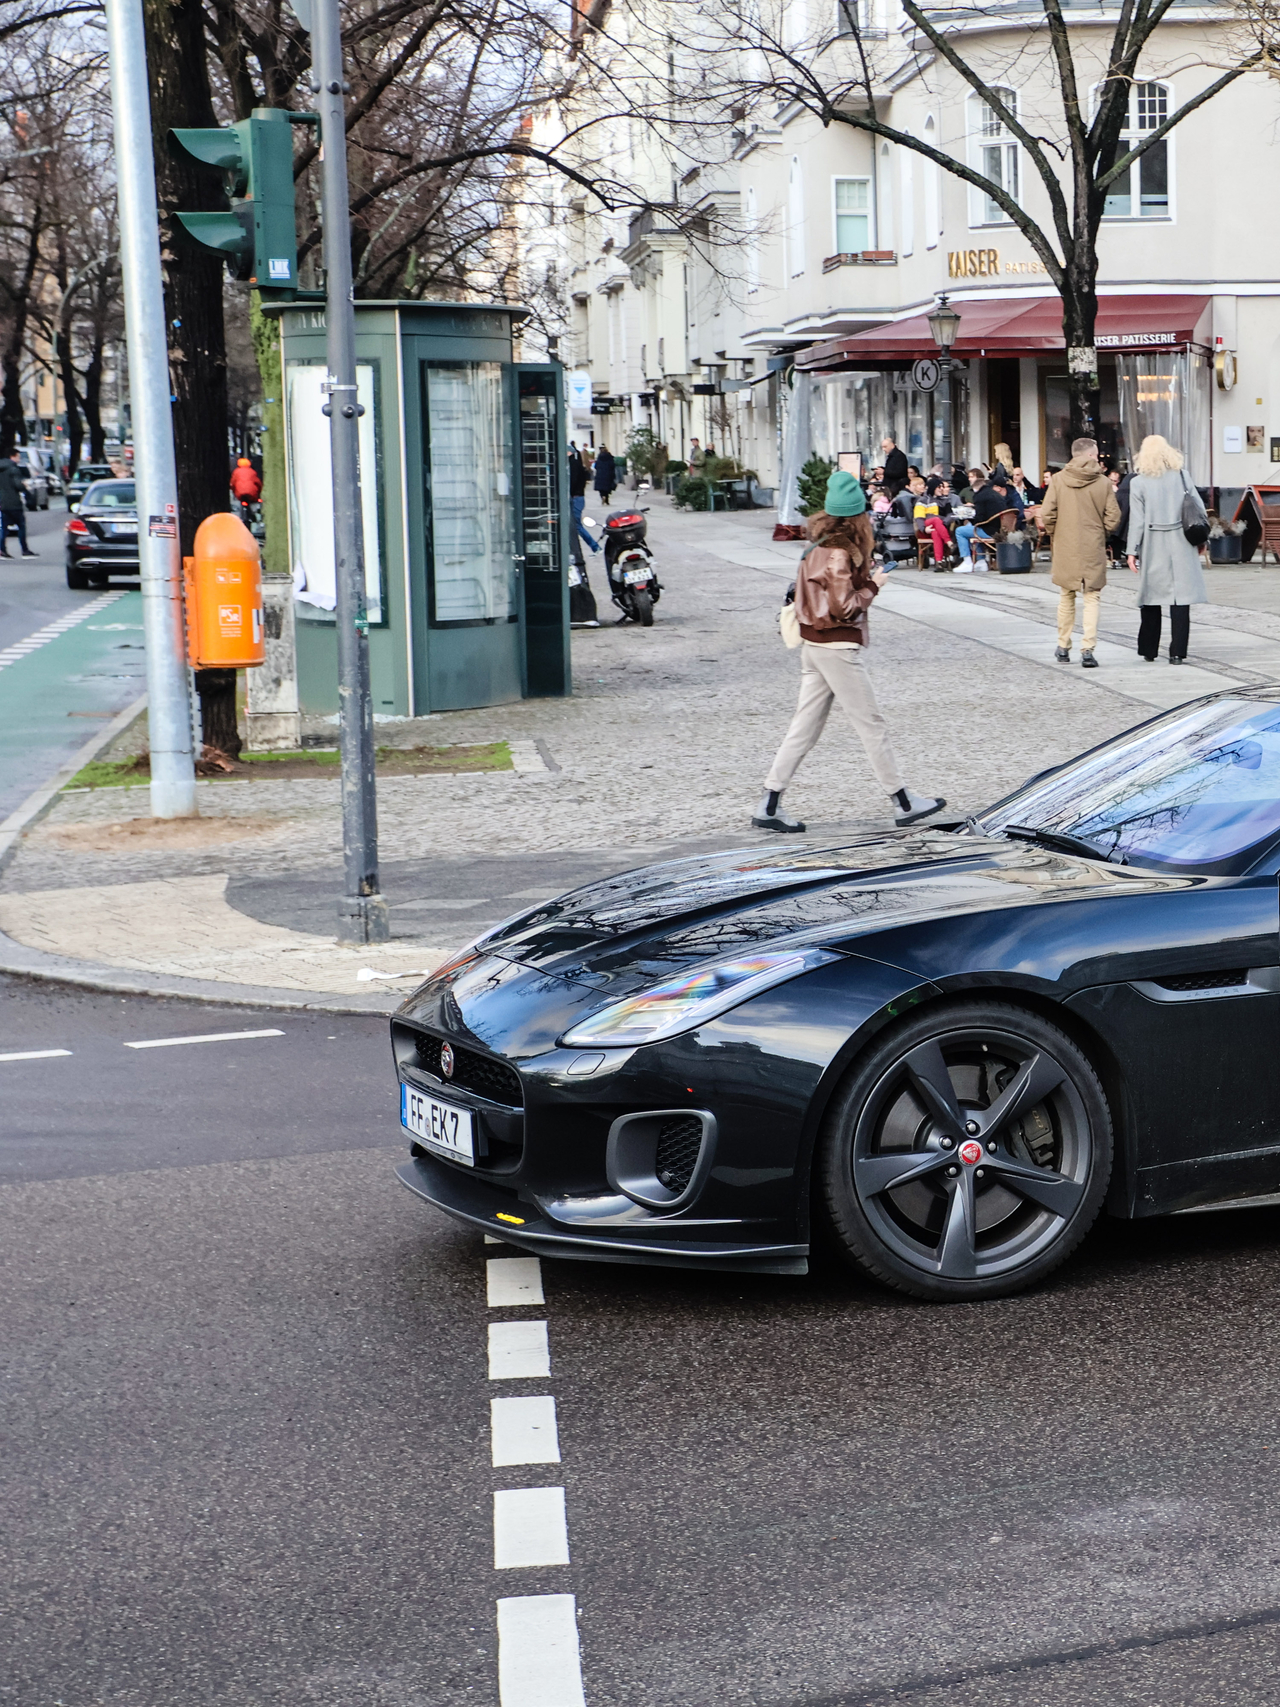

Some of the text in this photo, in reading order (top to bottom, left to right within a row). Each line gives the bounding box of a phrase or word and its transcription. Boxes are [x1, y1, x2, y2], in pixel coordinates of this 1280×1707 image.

[947, 248, 999, 278] KAISER
[1122, 333, 1177, 345] PATISSERIE
[921, 366, 931, 382] K
[1186, 988, 1240, 998] JAGUAR
[411, 1094, 424, 1130] FF
